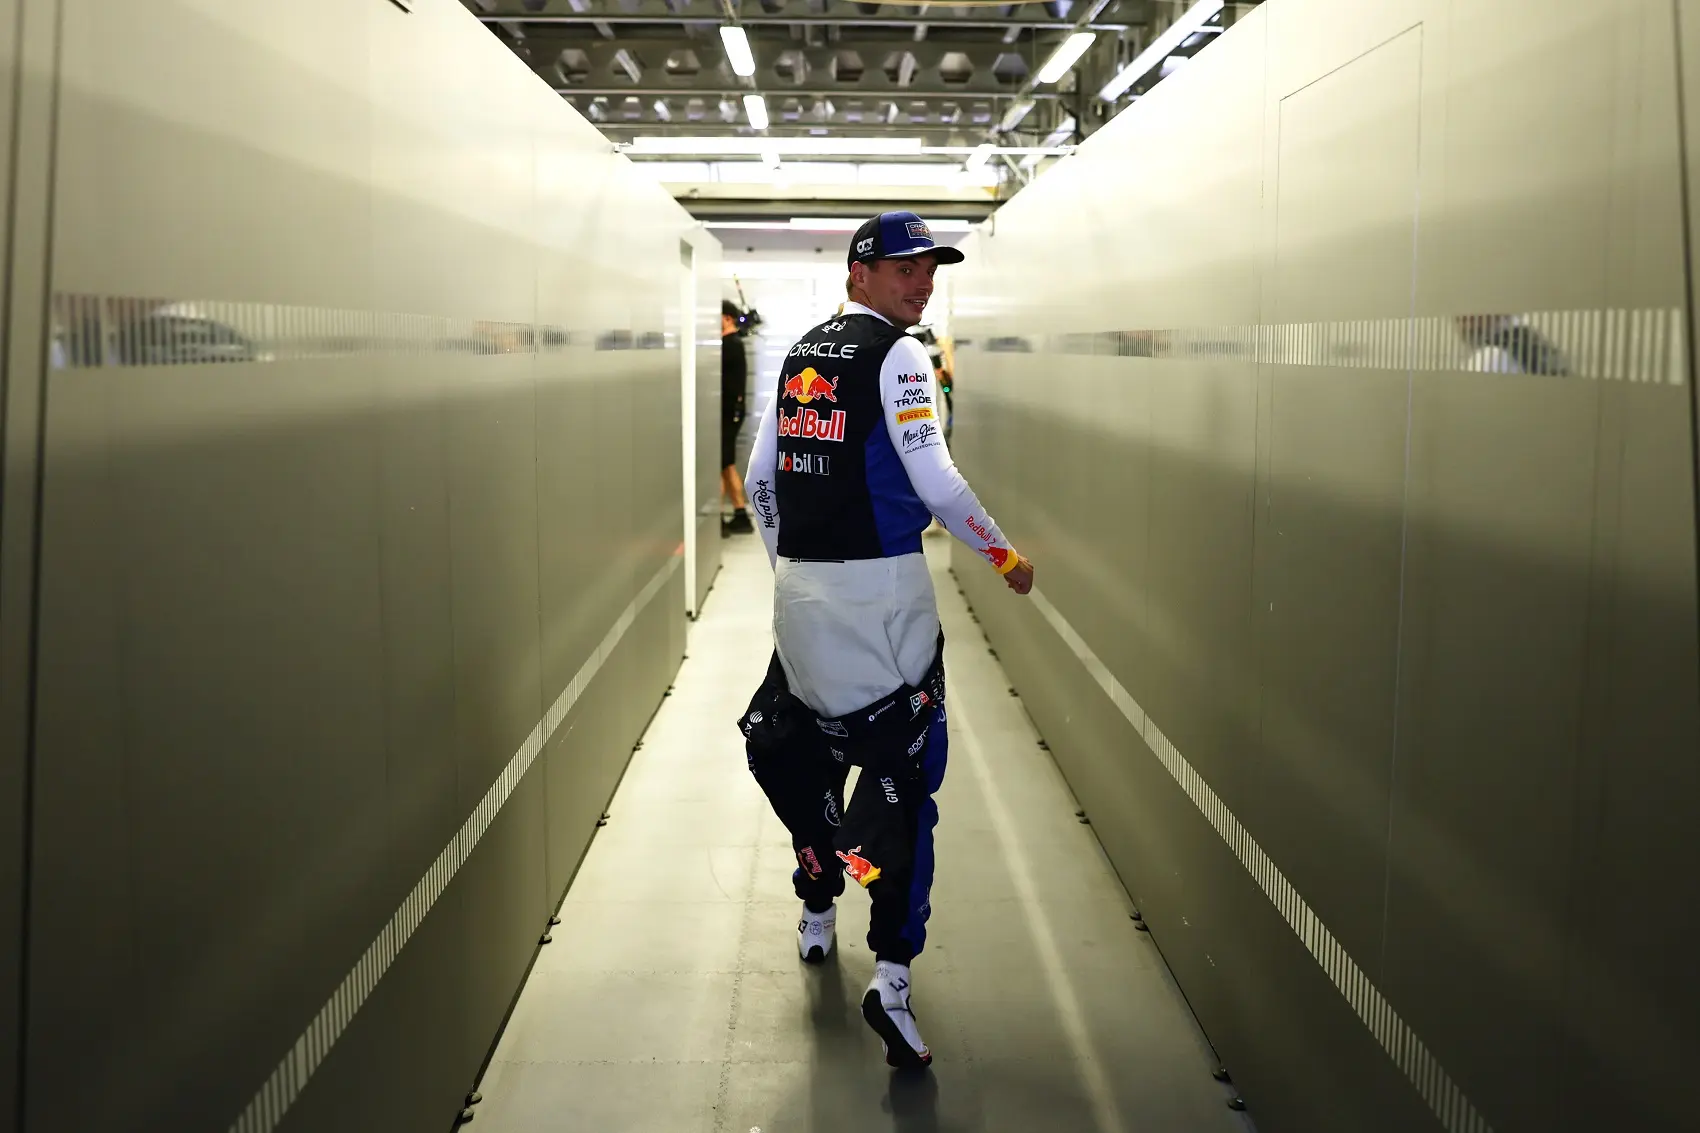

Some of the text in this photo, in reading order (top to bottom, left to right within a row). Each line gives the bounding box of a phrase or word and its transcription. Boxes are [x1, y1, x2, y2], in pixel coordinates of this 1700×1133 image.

[789, 342, 859, 359] ORACLE
[897, 373, 928, 384] Mobil
[903, 388, 924, 397] AVA
[894, 396, 932, 407] TRADE
[802, 408, 846, 442] Bull
[778, 451, 812, 474] Mobil
[756, 479, 775, 528] Hard Rock
